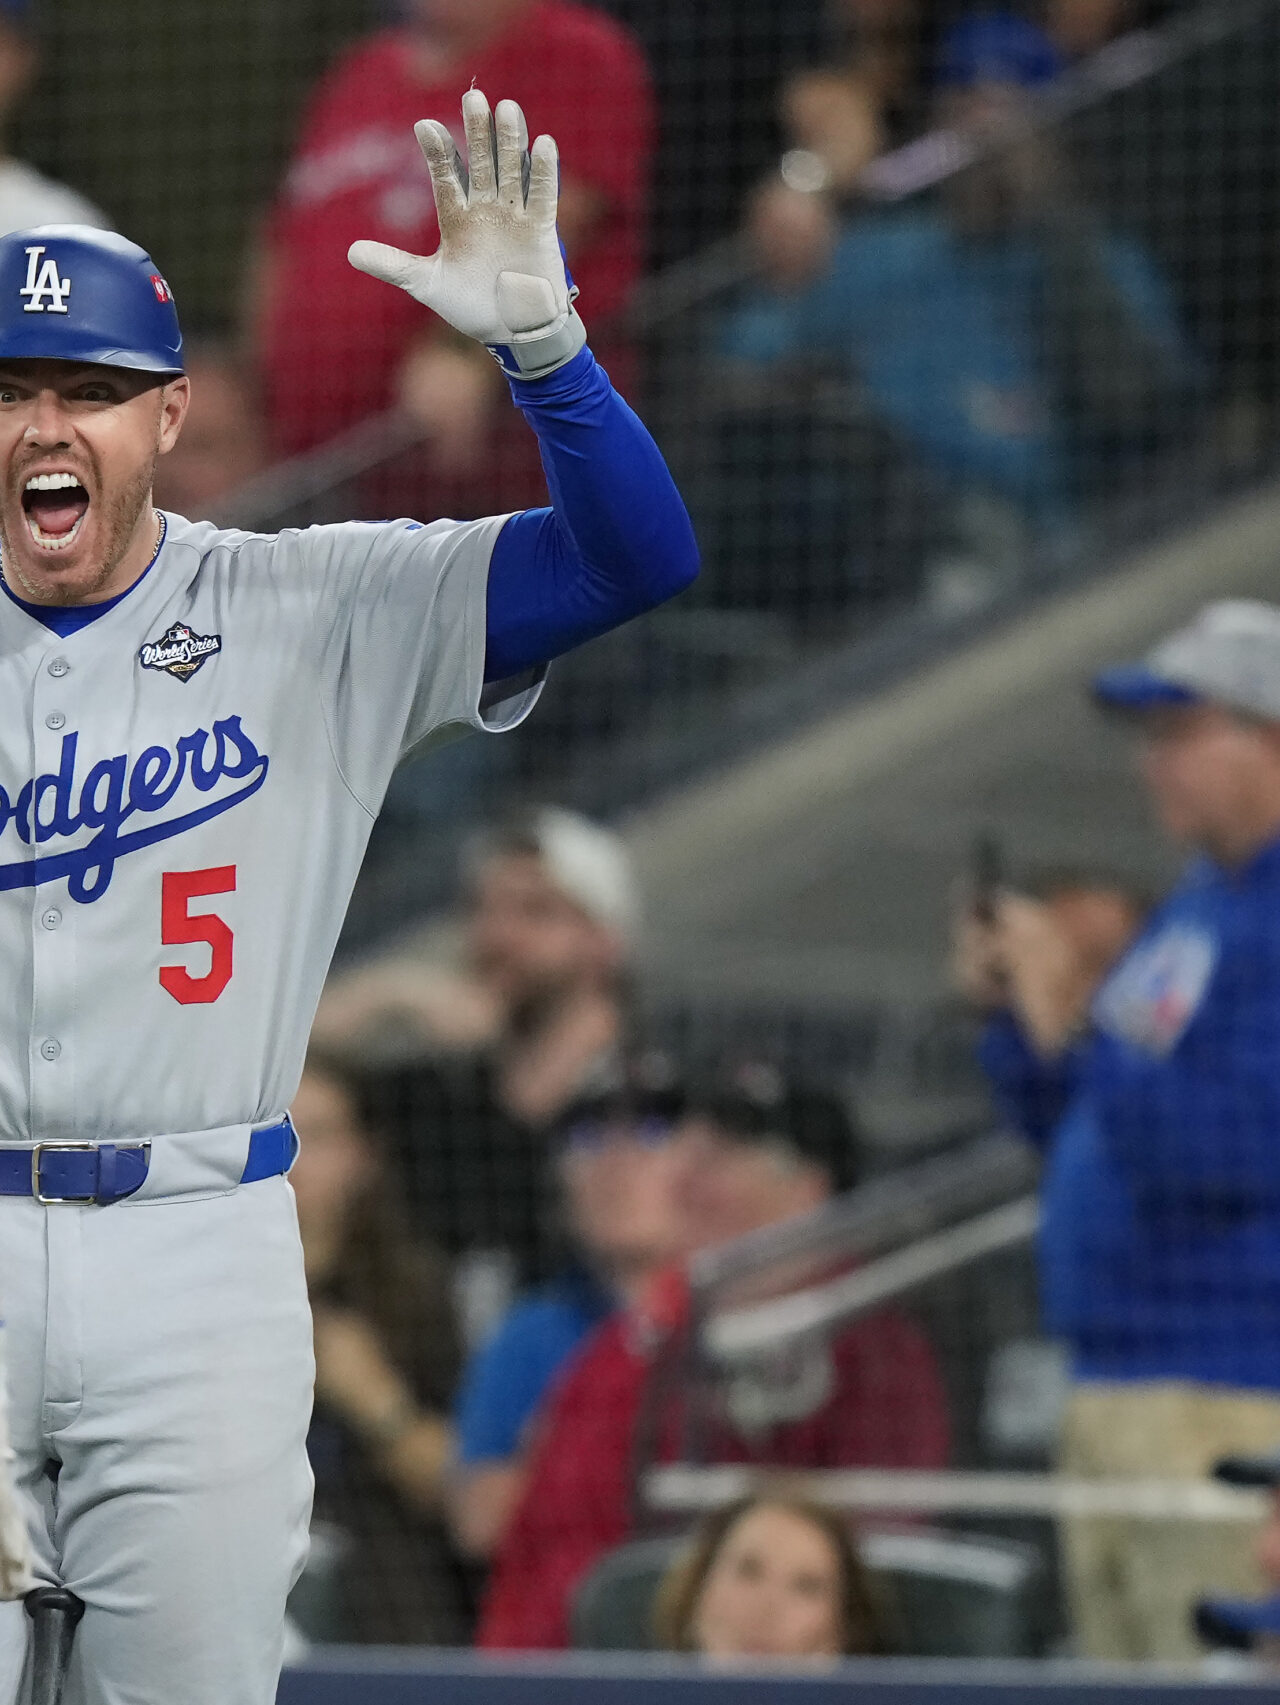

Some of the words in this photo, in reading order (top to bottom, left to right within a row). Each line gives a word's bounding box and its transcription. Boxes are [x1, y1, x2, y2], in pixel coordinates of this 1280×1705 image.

[20, 246, 71, 312] LA
[141, 642, 187, 667] World
[179, 637, 220, 664] Series
[159, 864, 237, 1005] 5
